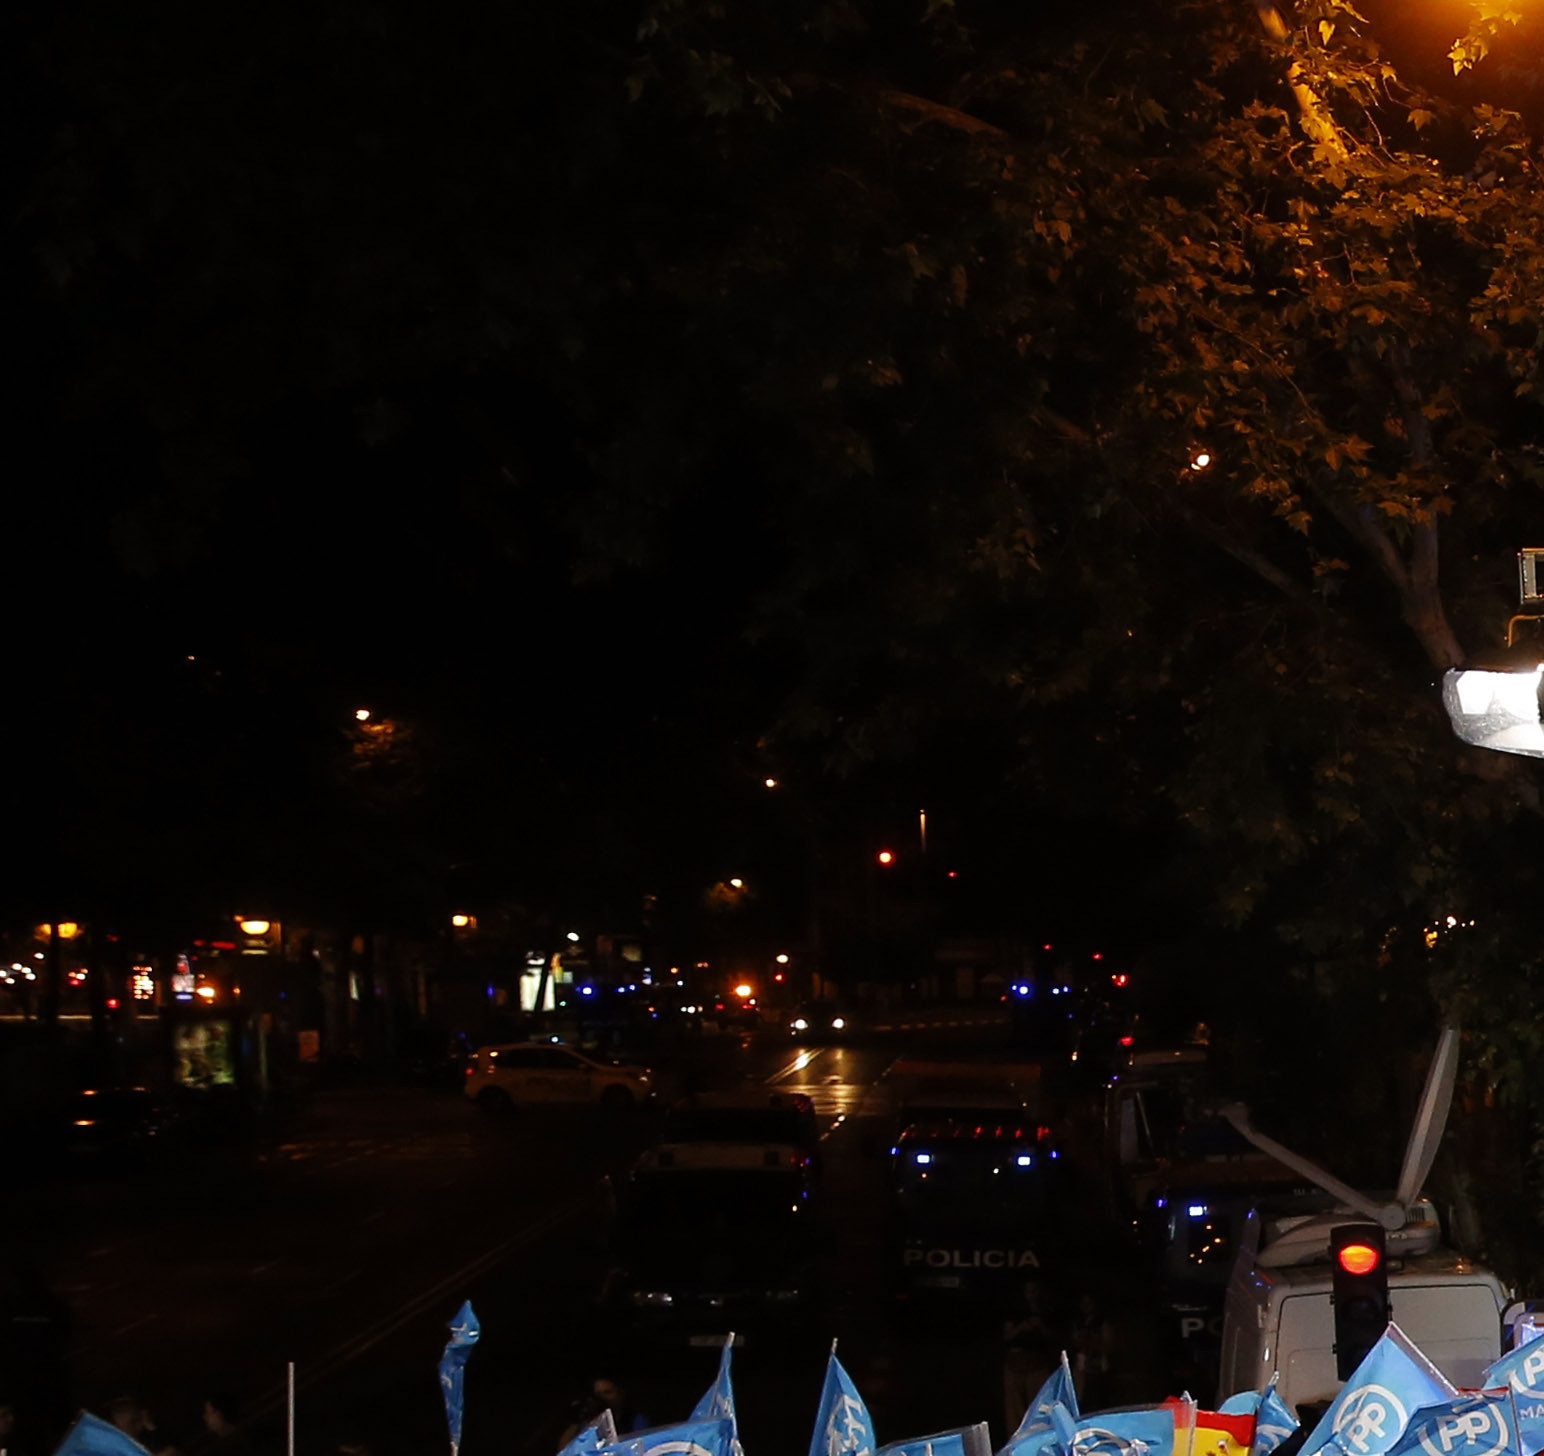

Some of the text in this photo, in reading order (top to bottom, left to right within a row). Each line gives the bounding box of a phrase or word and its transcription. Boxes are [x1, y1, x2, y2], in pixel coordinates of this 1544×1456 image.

[903, 1248, 1041, 1270] POLICIA
[1346, 1402, 1387, 1454] PP
[1436, 1410, 1491, 1452] PP
